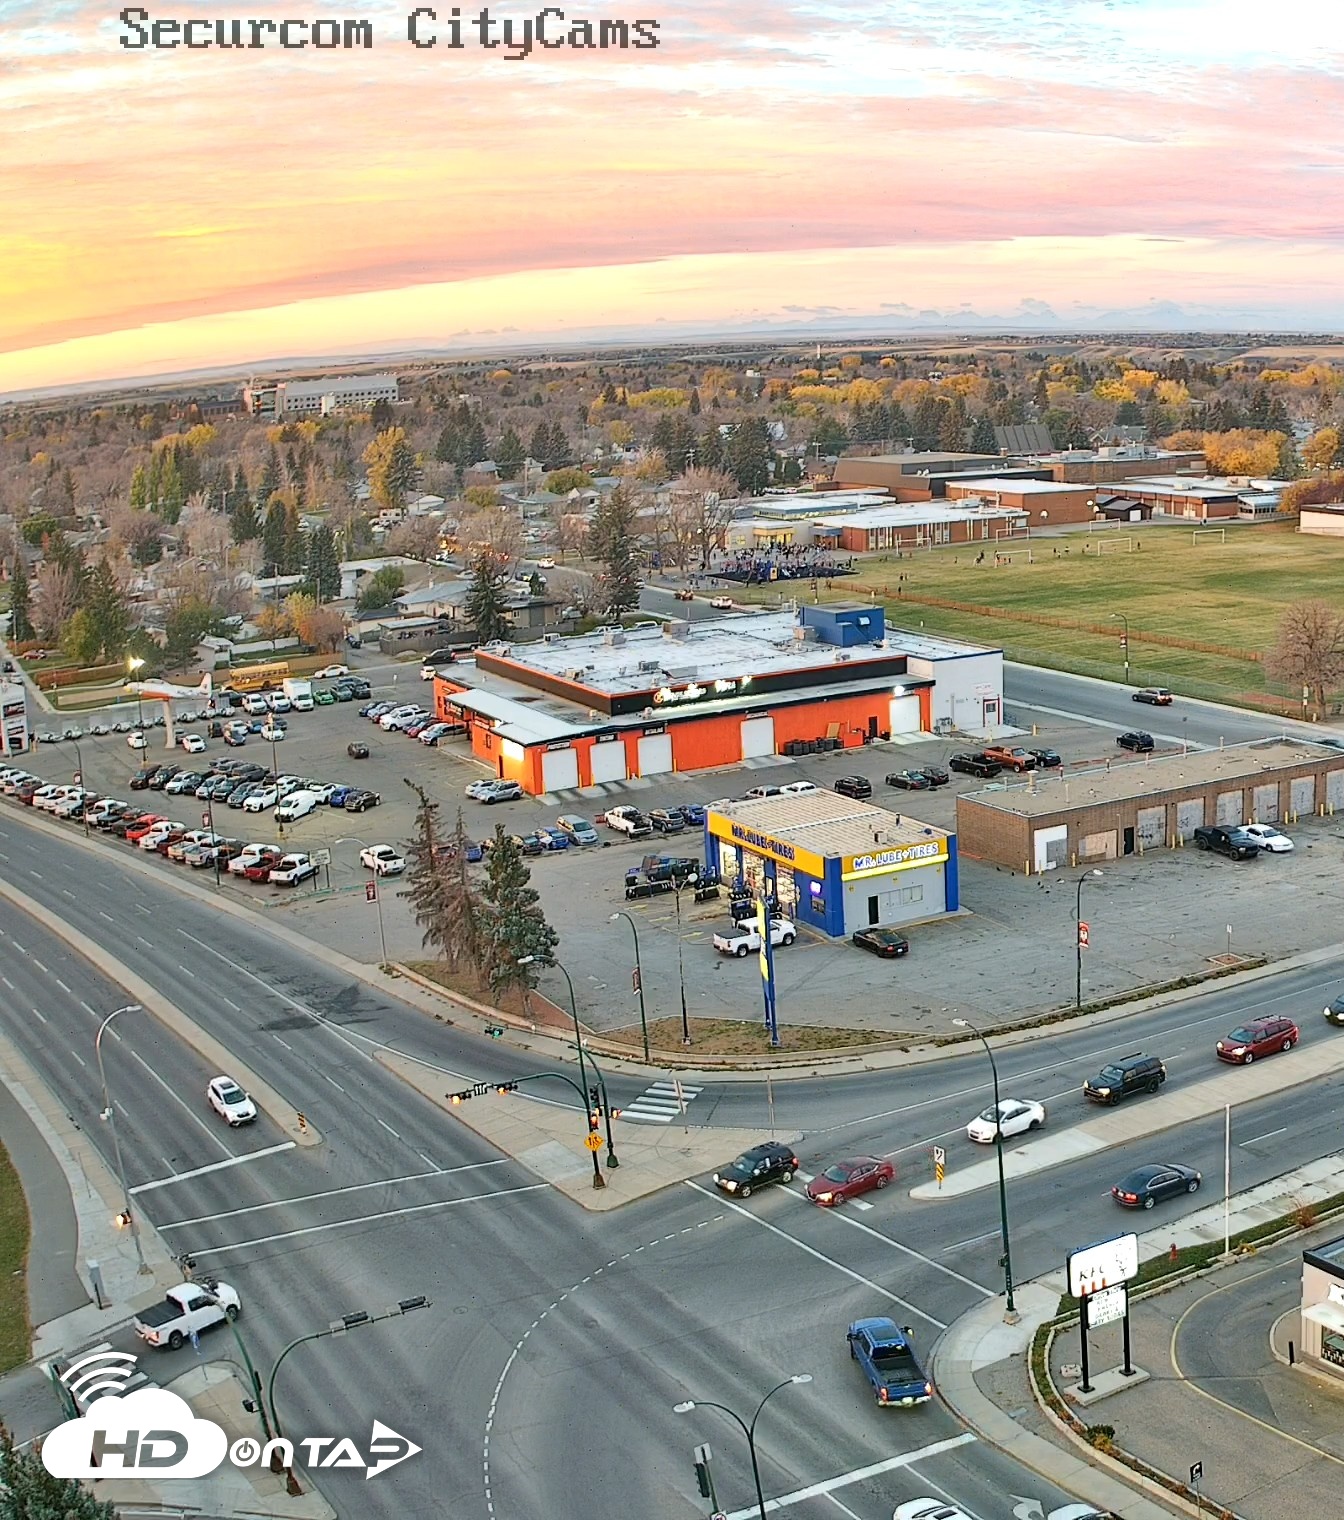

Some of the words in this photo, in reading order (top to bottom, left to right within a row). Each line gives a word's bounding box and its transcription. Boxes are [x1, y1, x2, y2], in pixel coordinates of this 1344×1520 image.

[747, 830, 767, 849] LUBE
[772, 838, 795, 861] TIRES
[853, 855, 876, 870] MR.
[877, 849, 901, 865] LUBE
[909, 842, 939, 859] TIRES
